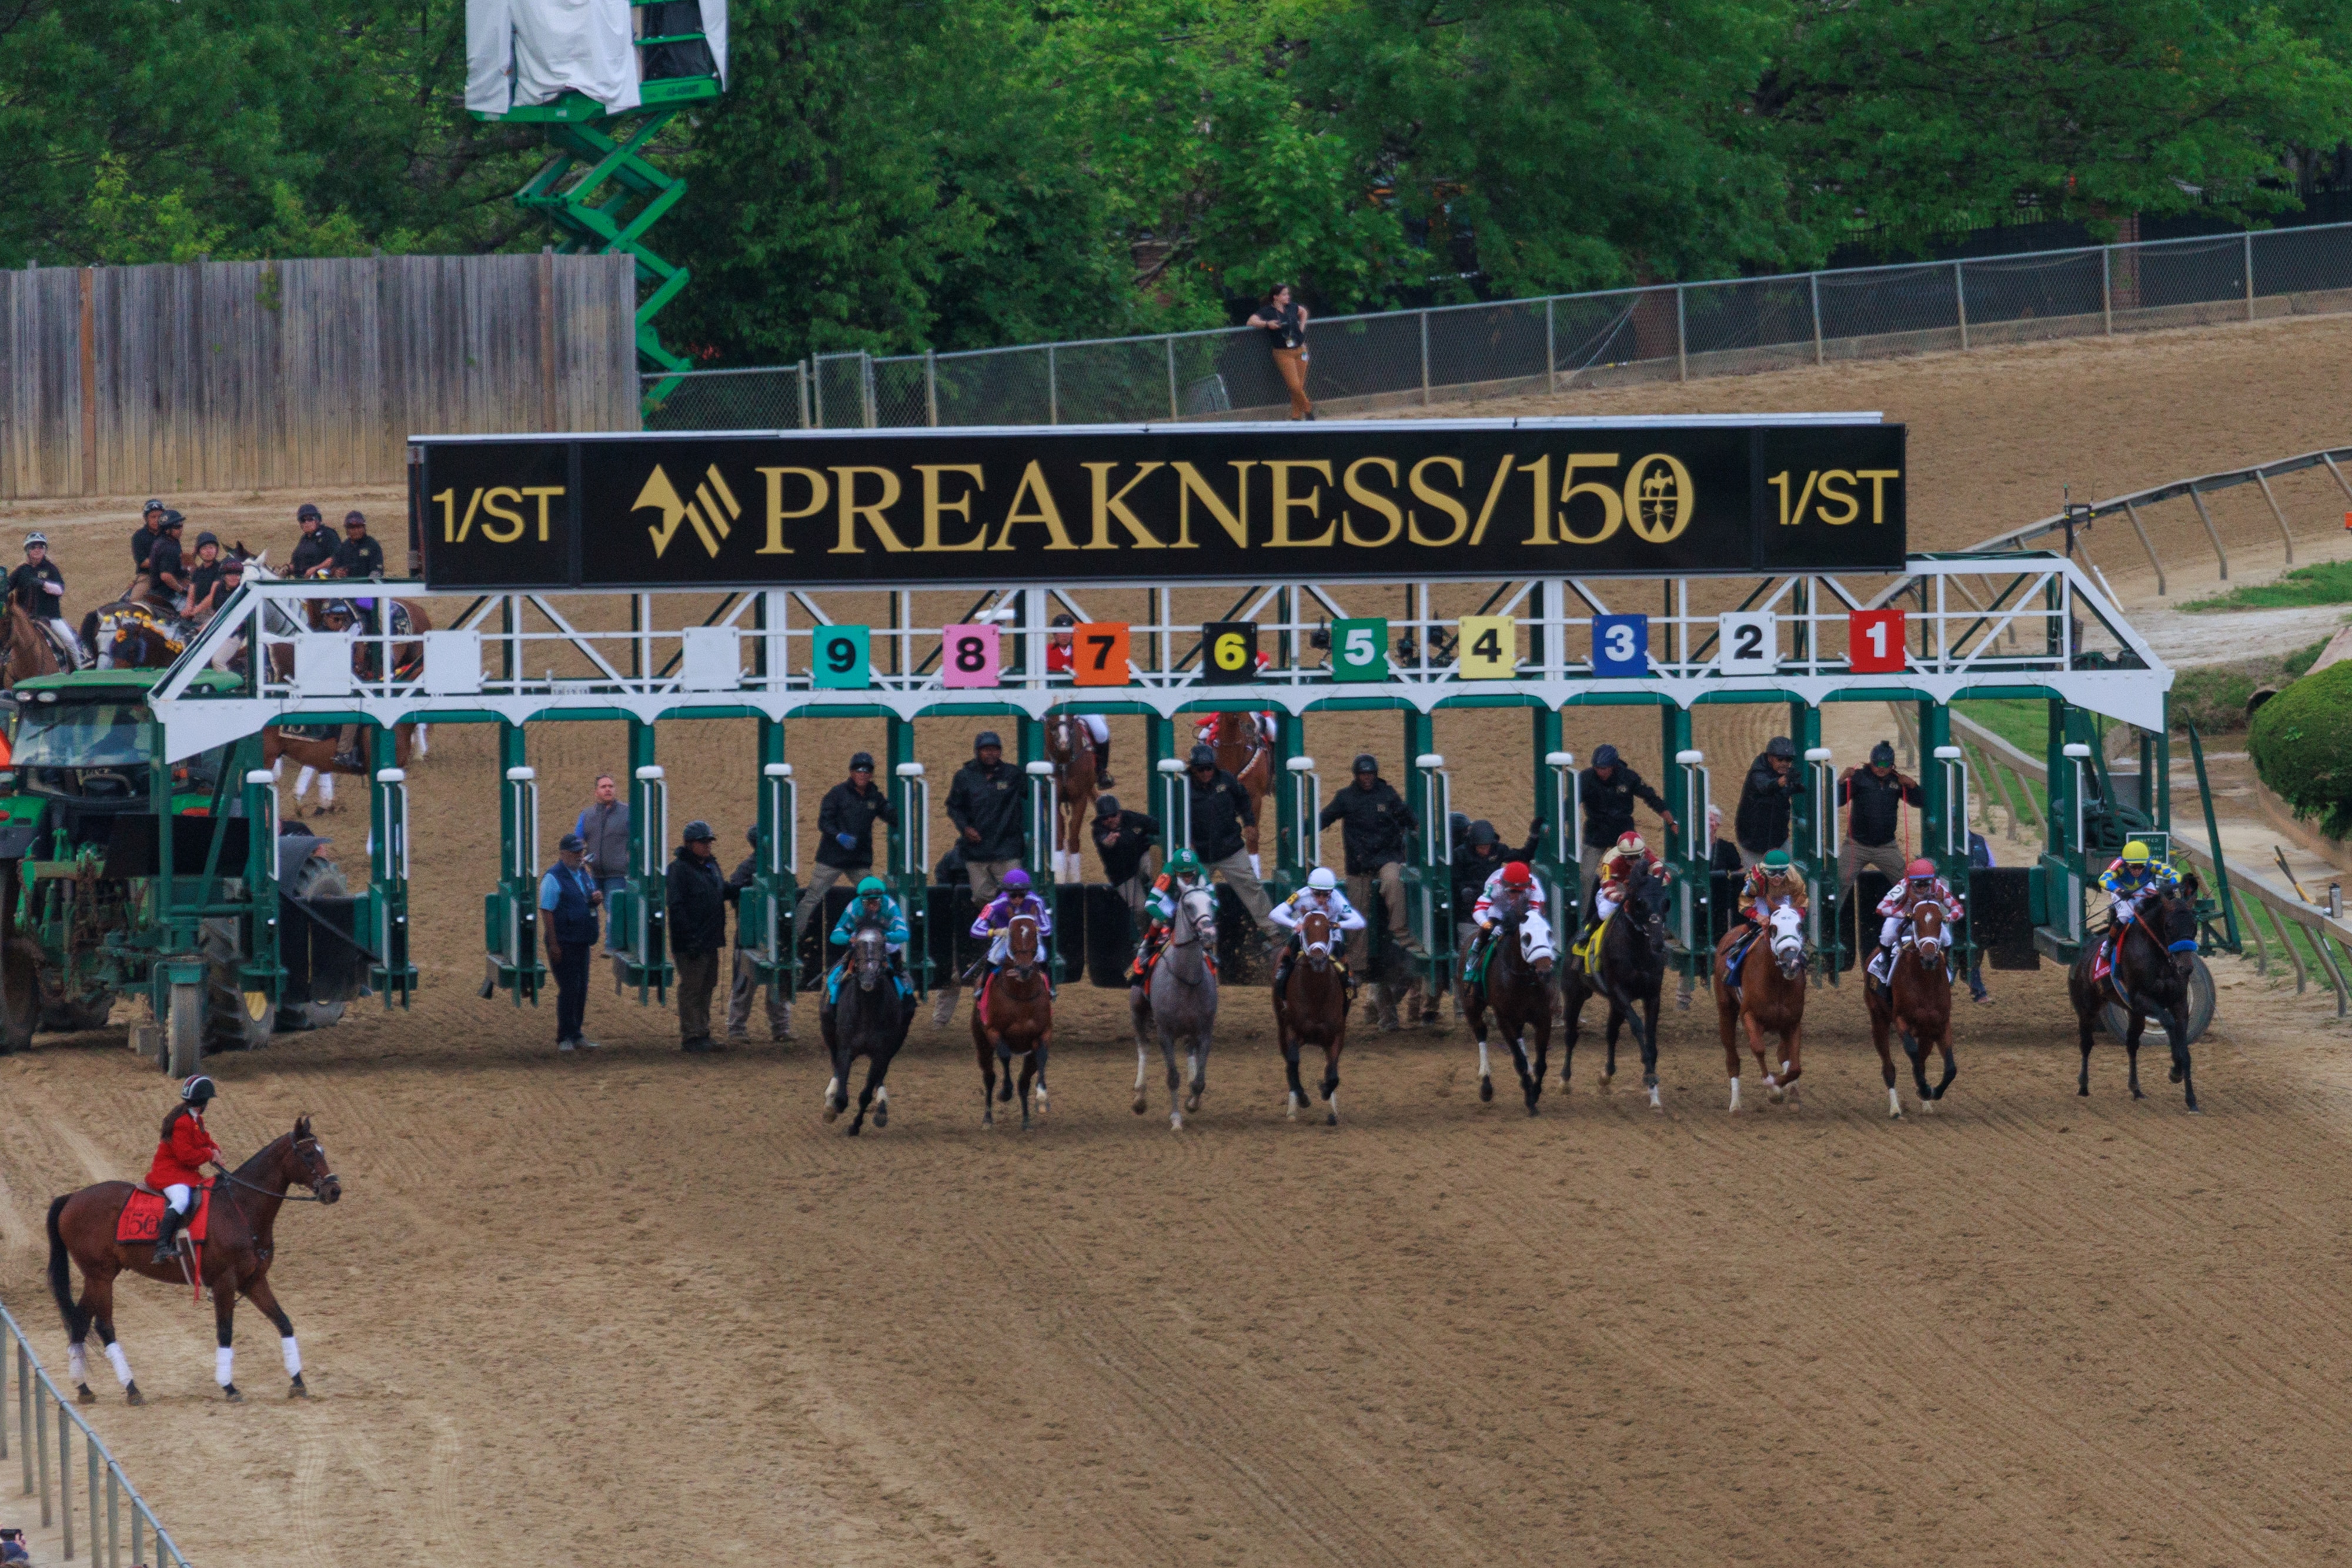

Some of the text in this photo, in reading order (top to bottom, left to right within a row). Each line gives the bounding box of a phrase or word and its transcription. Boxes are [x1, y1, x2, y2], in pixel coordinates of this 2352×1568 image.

[433, 486, 565, 543] 1/ST
[755, 453, 1695, 554] PREAKNESS/150
[1768, 469, 1899, 526] 1/ST
[826, 637, 857, 674] 9
[956, 636, 985, 673] 8
[1087, 634, 1116, 670] 7
[1214, 633, 1246, 670] 6
[1345, 629, 1374, 666] 5
[1472, 628, 1502, 663] 4
[1605, 624, 1635, 661] 3
[1734, 624, 1763, 660] 2
[1866, 621, 1886, 658] 1
[1889, 887, 1902, 898] 2
